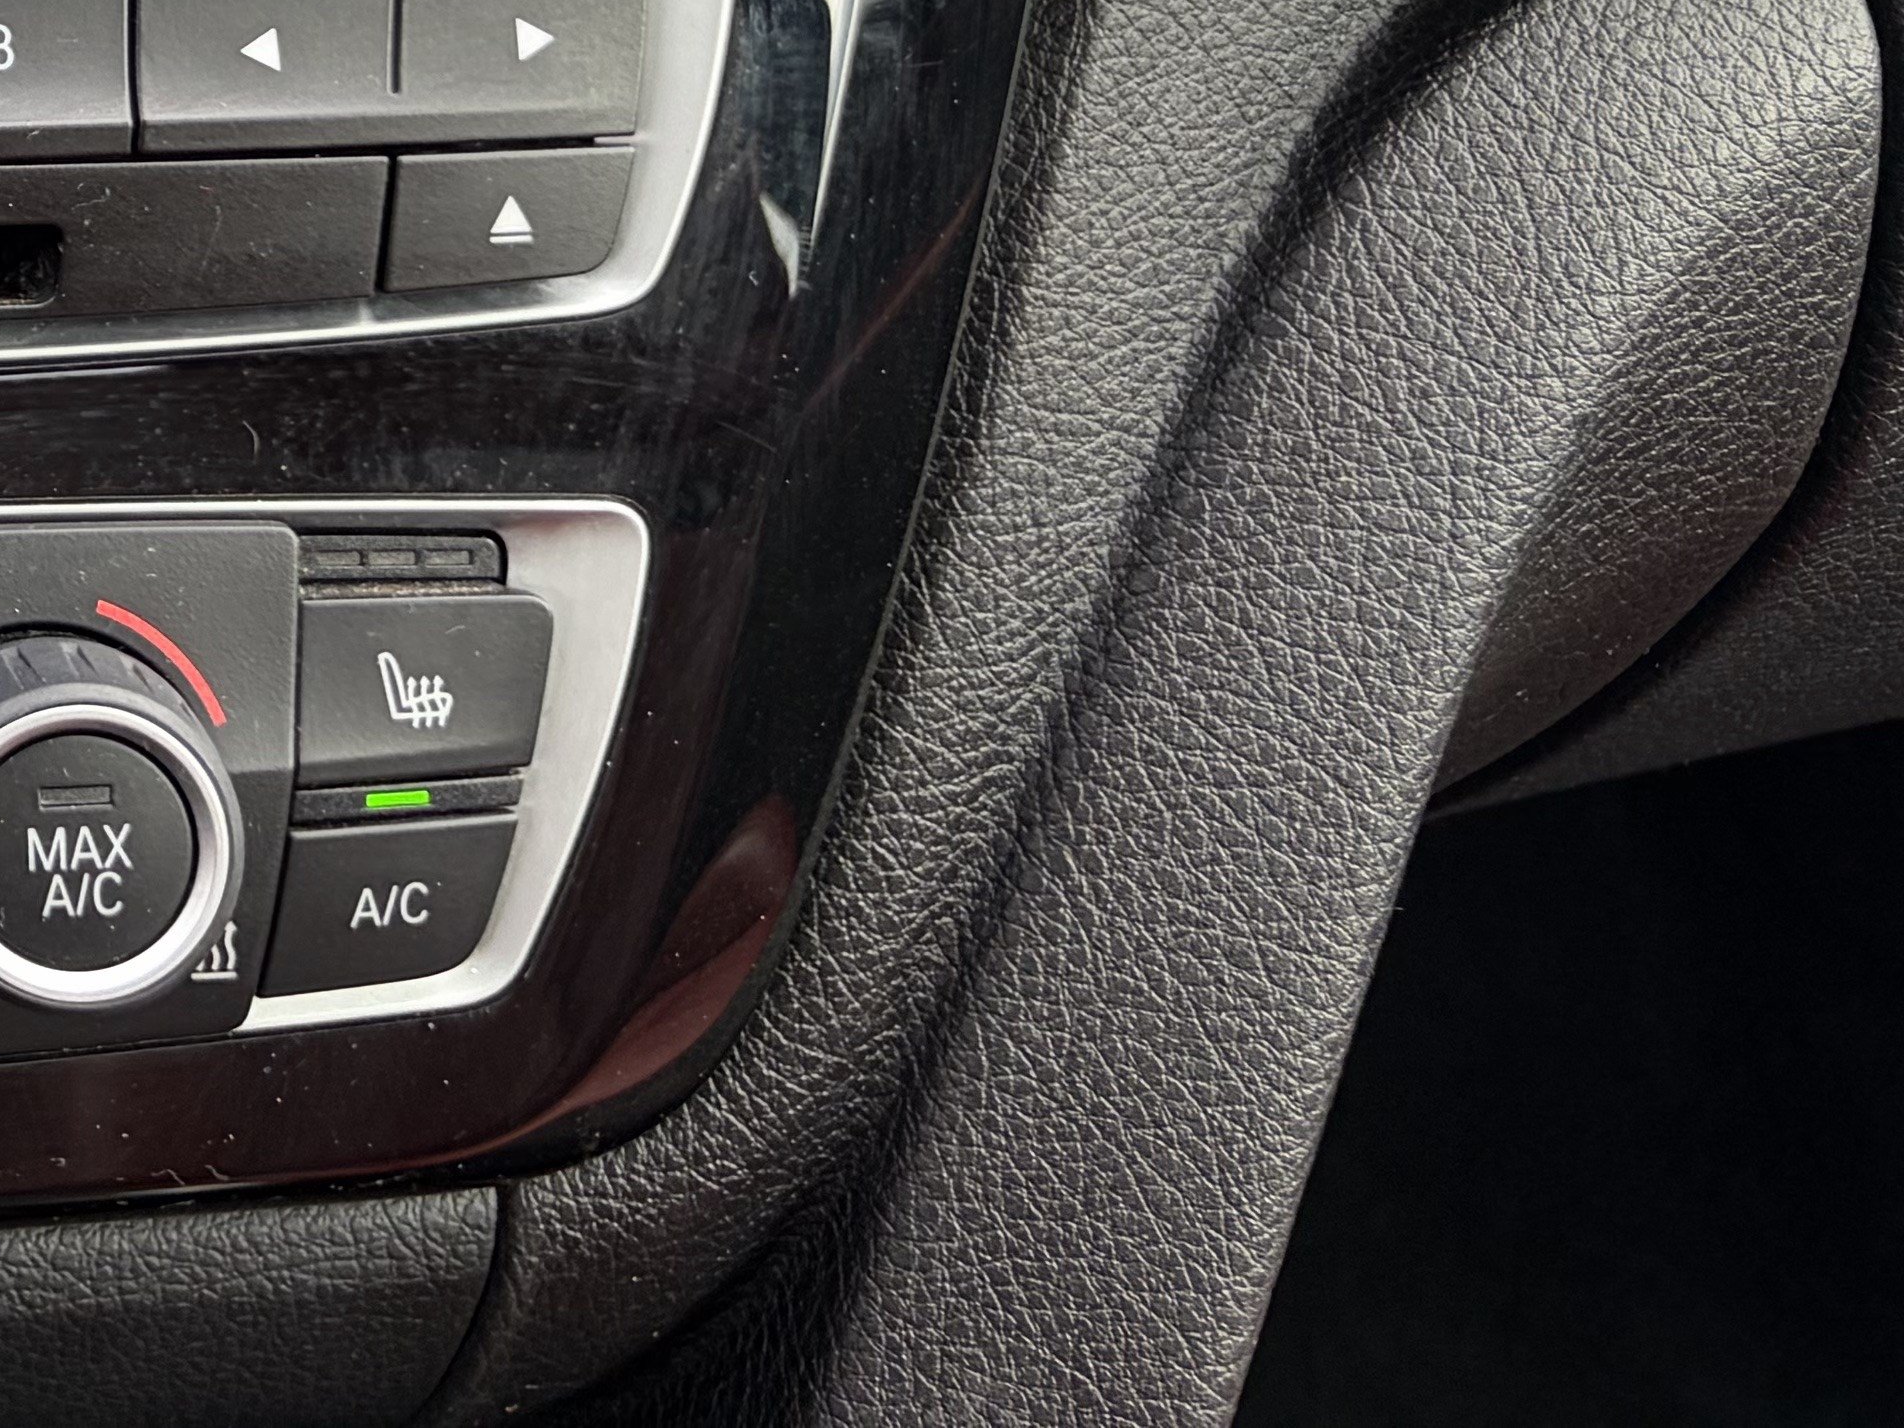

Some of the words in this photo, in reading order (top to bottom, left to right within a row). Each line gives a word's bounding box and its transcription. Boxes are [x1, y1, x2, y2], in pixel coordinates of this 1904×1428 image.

[27, 824, 134, 872] MAX
[42, 872, 123, 919] A/C
[350, 881, 430, 930] A/C
